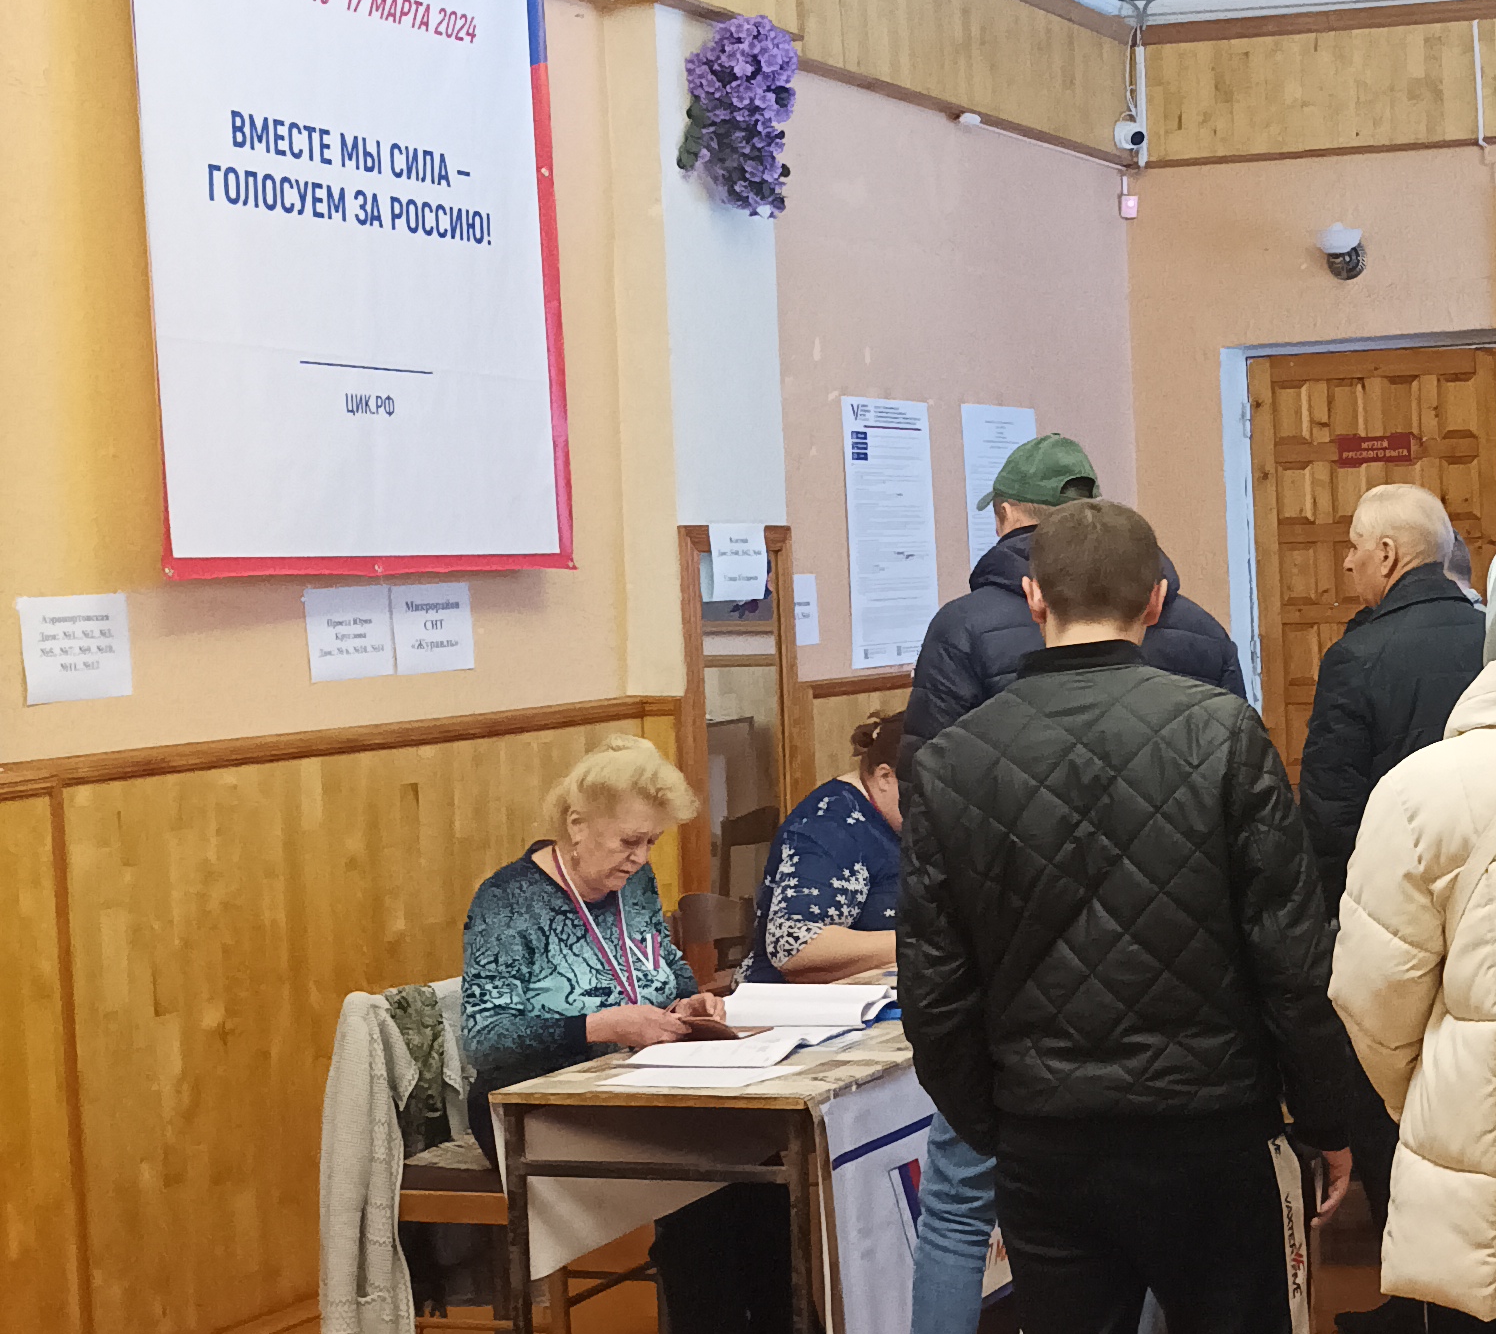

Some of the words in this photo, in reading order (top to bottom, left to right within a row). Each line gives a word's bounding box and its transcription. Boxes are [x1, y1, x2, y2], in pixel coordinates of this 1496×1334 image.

[434, 7, 477, 44] 2024
[230, 109, 332, 166] ВМЕСТЕ
[340, 132, 382, 176] МЫ
[389, 142, 451, 188] СИЛА
[207, 163, 347, 223] ГОЛОСУЕМ
[354, 189, 384, 230] ЗА
[390, 195, 492, 246] РОССИЮ!
[345, 392, 395, 417] ЦИК.РФ
